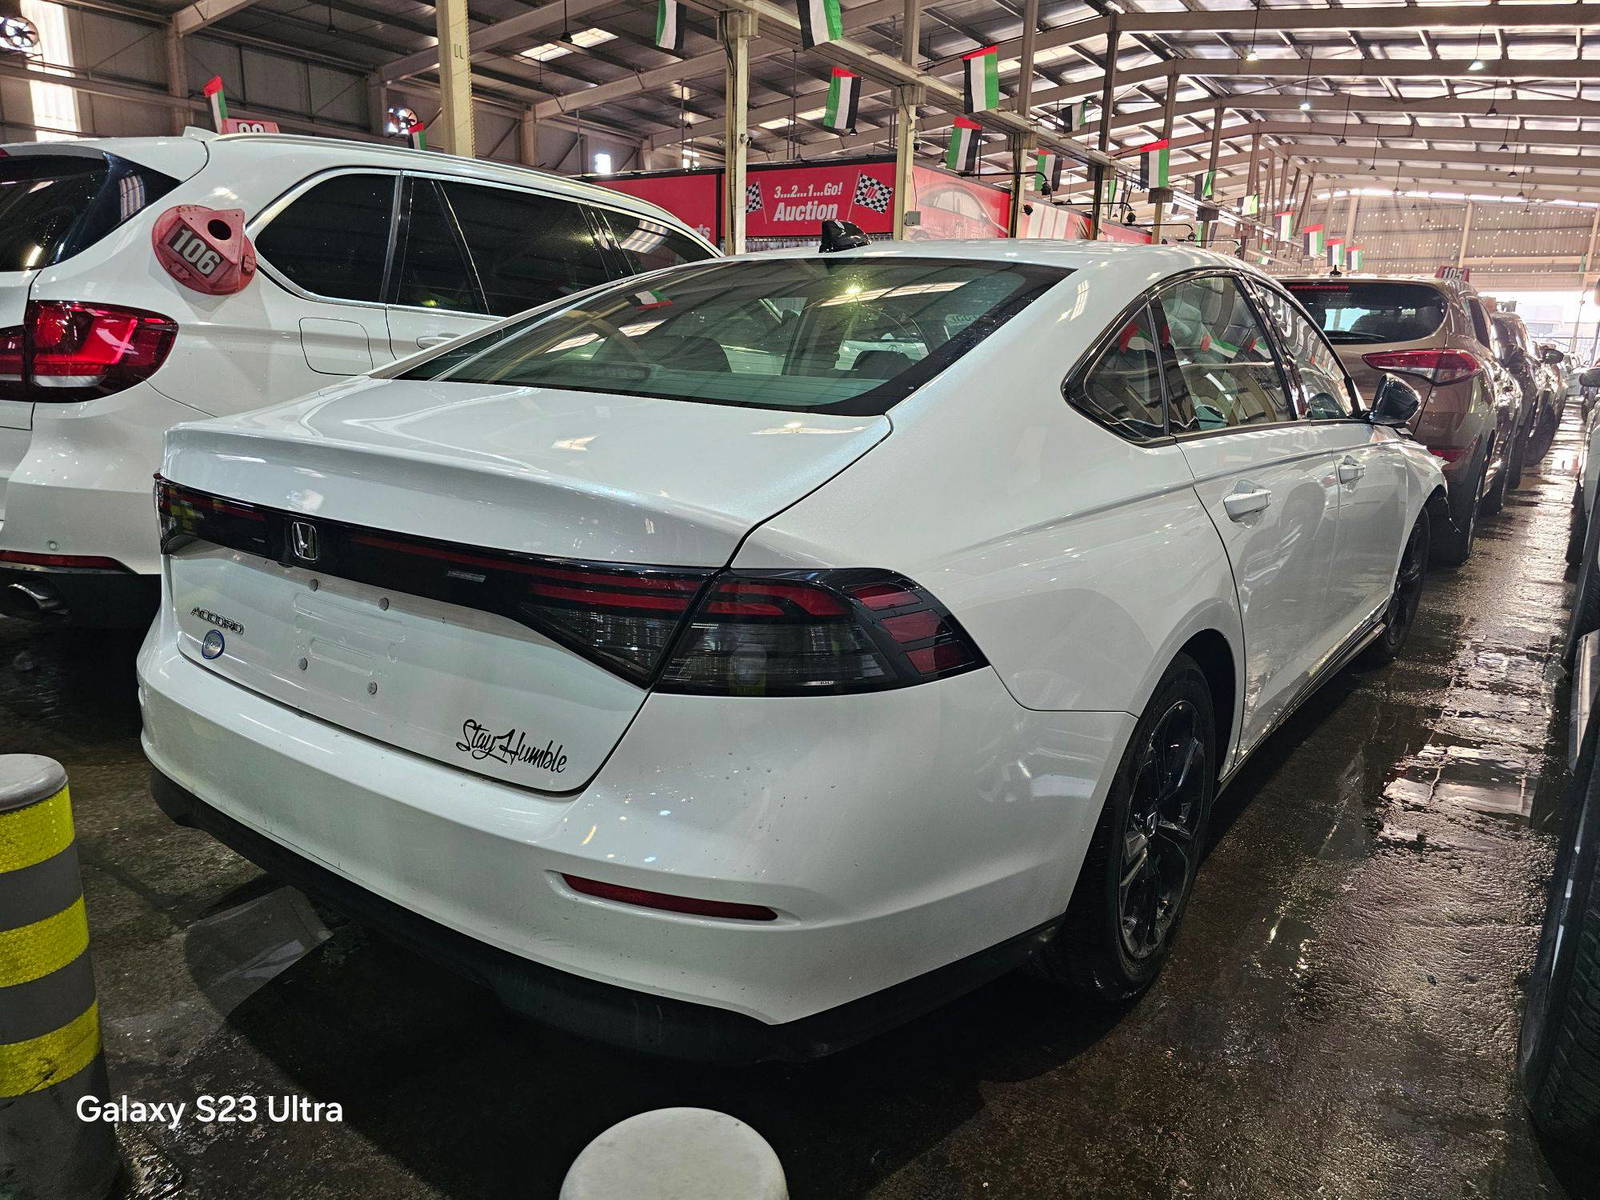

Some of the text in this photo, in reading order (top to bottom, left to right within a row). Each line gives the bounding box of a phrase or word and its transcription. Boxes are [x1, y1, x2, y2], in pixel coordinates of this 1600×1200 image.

[773, 200, 838, 222] Auction
[172, 228, 221, 275] 106
[1443, 267, 1463, 281] 105
[190, 606, 245, 636] ACCORD
[456, 719, 567, 773] Stay Humble
